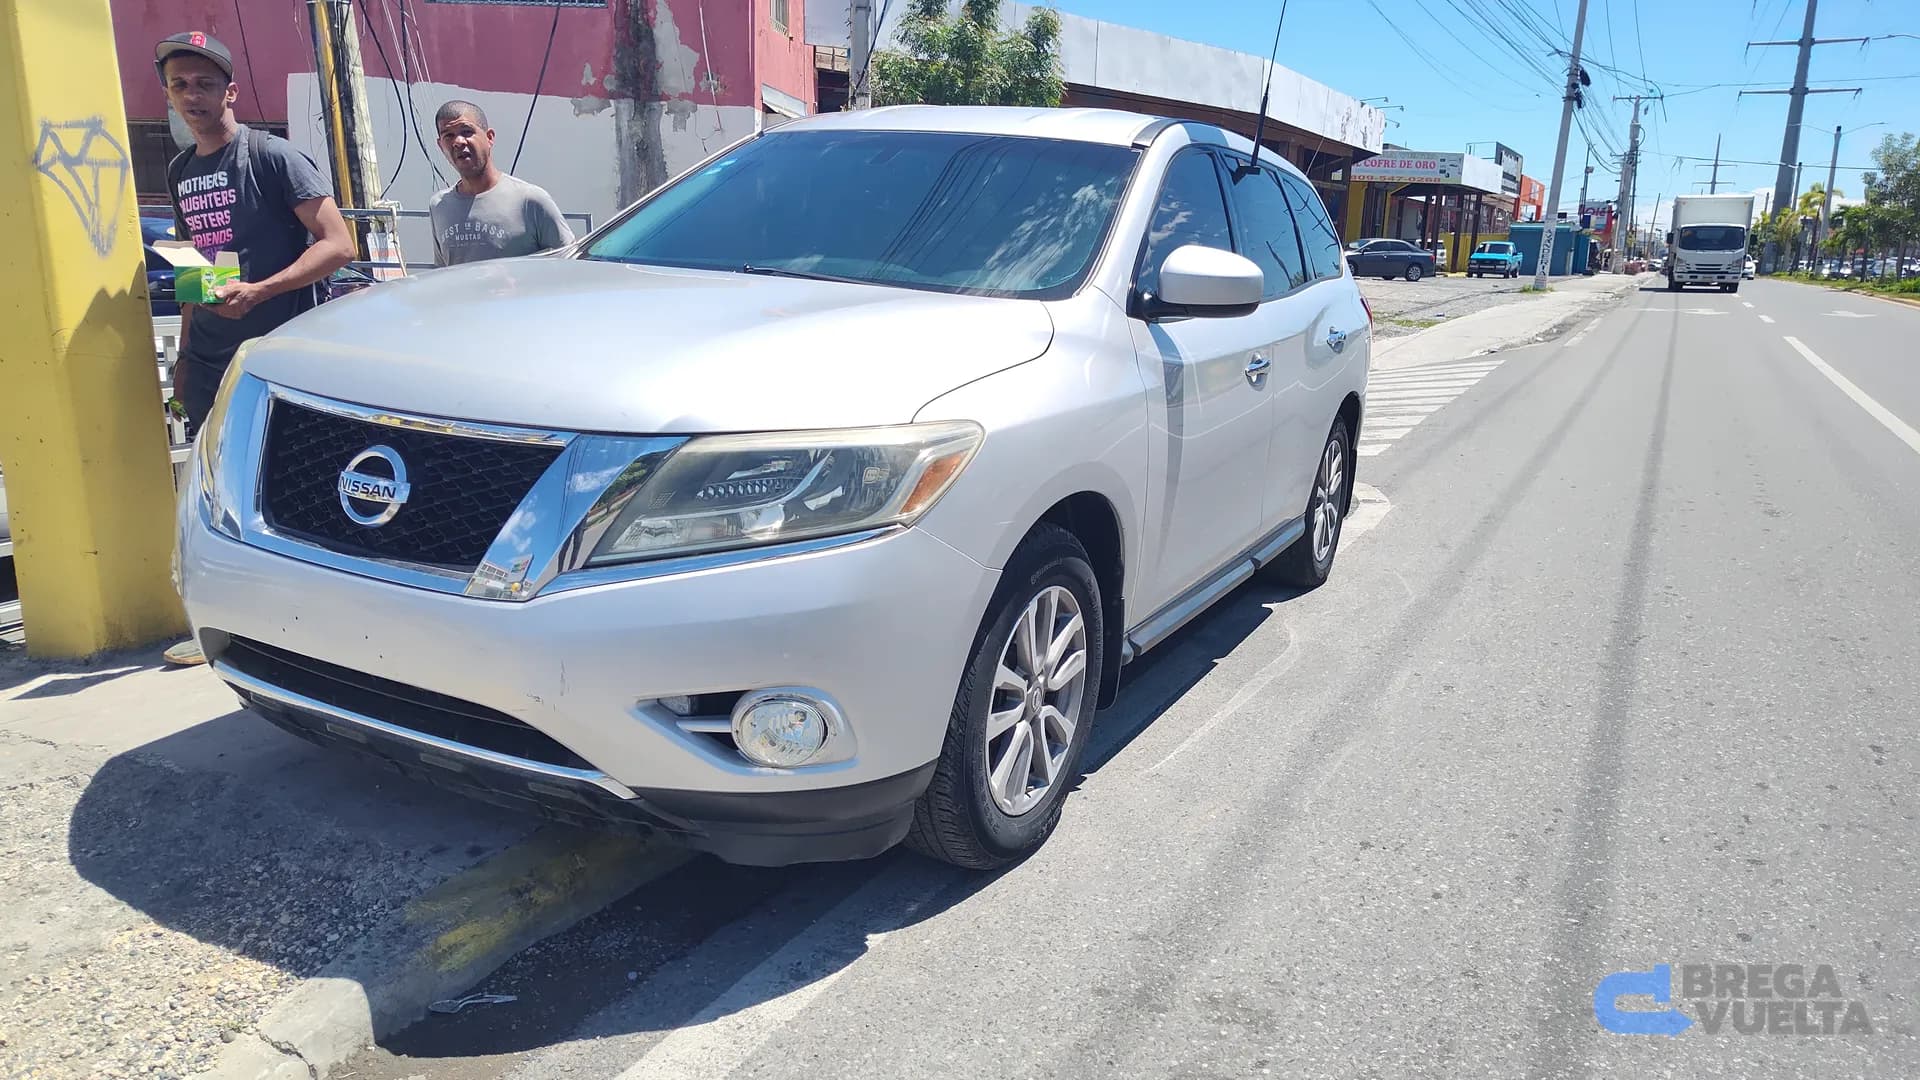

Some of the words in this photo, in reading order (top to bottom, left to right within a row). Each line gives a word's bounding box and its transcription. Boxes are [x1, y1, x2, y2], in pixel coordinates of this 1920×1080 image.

[1363, 159, 1397, 168] COFRE
[1399, 160, 1412, 168] DE
[1415, 160, 1436, 169] ORO
[177, 171, 228, 197] MOTHERS
[185, 209, 231, 231] SISTERS
[475, 221, 505, 239] BASS
[191, 228, 233, 249] FRIENDS
[340, 476, 397, 499] NISSAN
